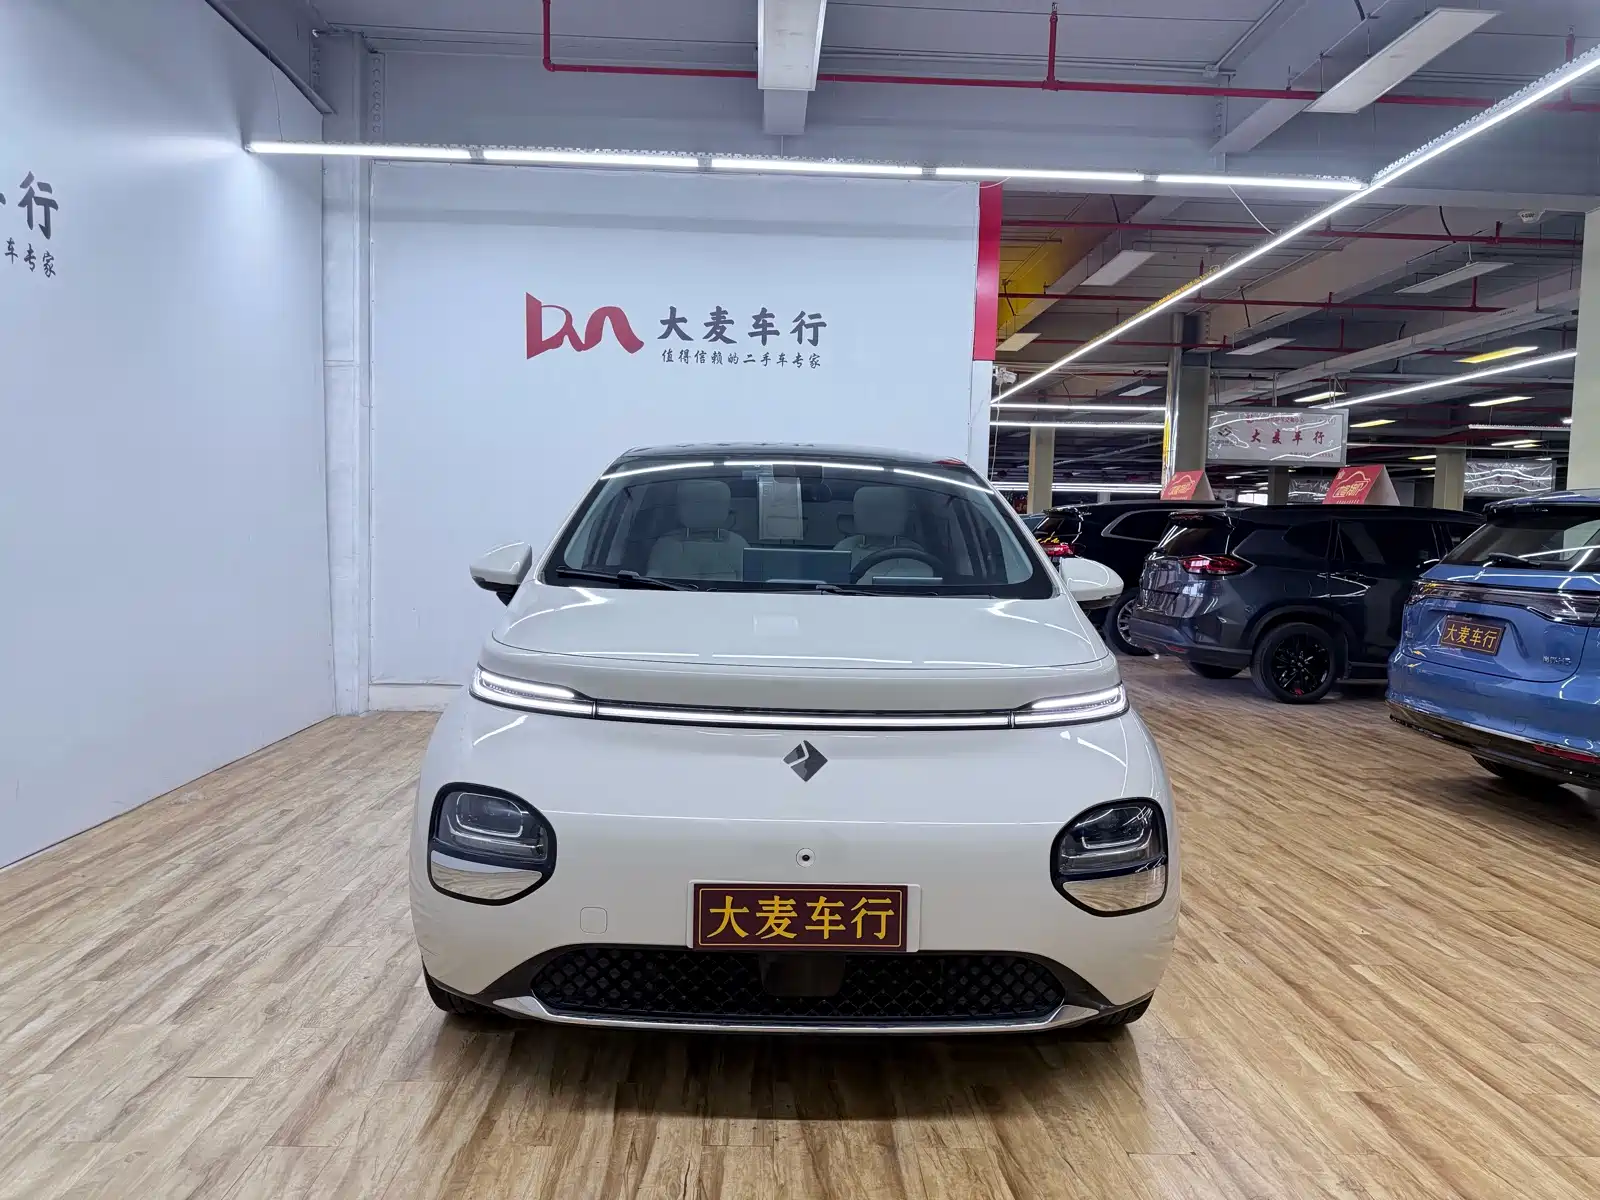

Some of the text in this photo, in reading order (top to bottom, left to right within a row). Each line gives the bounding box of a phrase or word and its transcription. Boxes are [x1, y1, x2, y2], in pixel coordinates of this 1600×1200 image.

[4, 237, 56, 278] 车专家
[657, 305, 827, 347] 大麦车行
[661, 349, 821, 369] 值得信赖的二手车专家
[1250, 428, 1325, 446] 大麦车行
[1443, 624, 1498, 649] 大麦车行
[706, 895, 895, 940] 大麦车行
